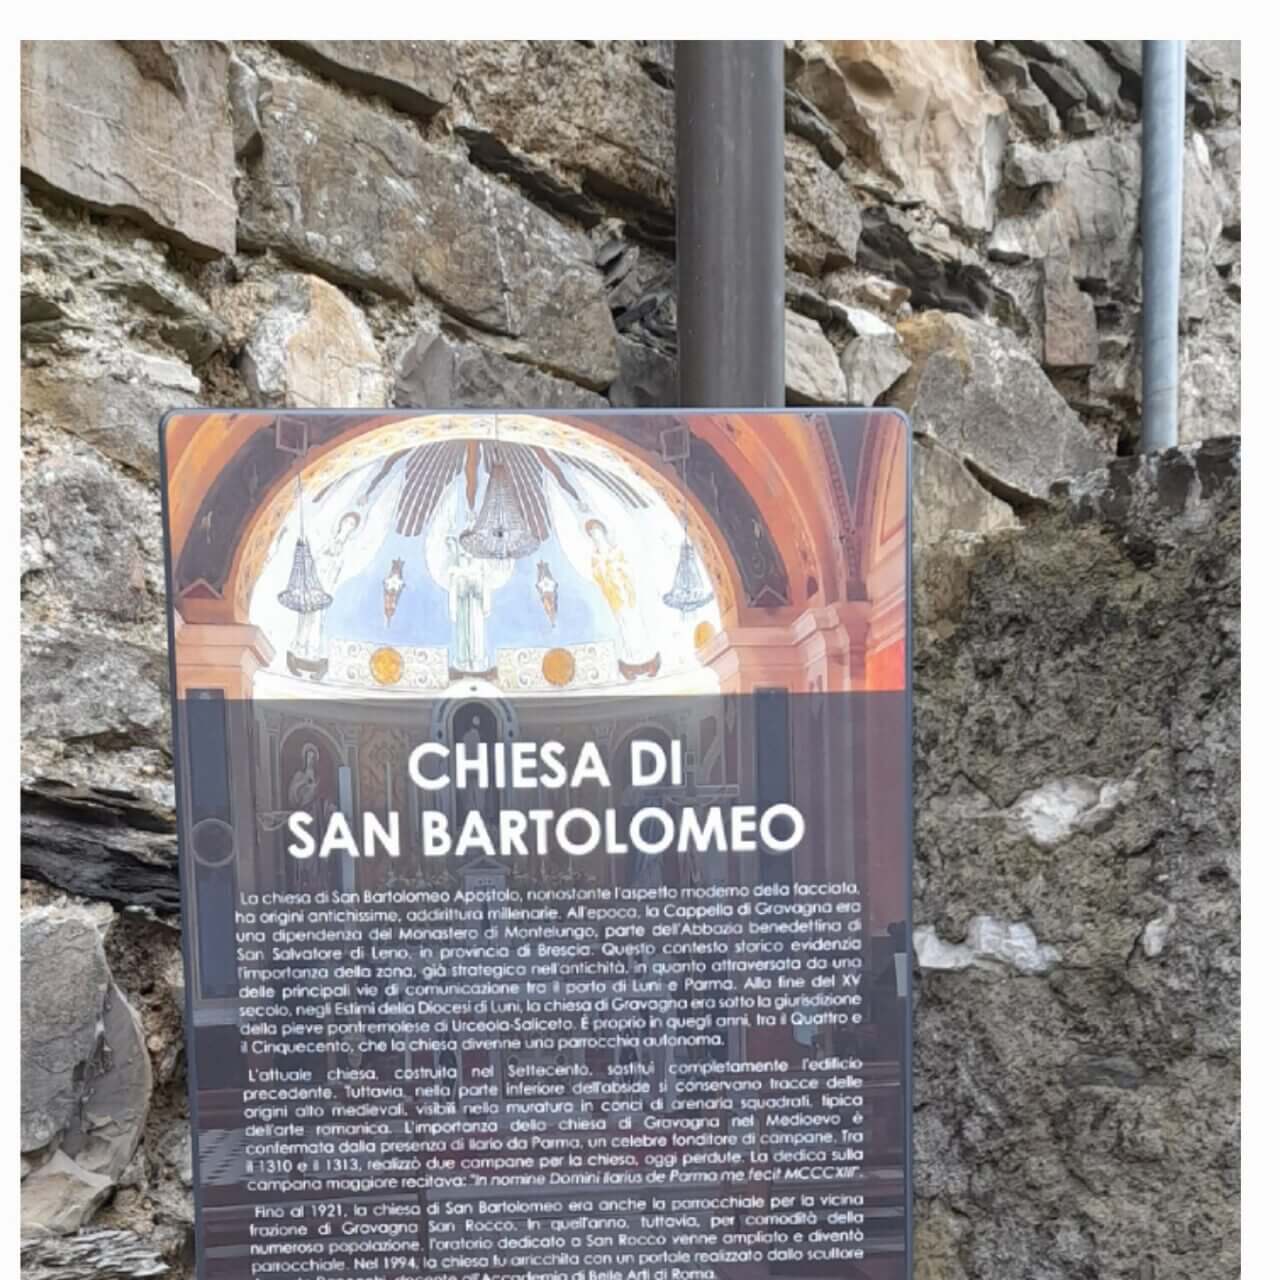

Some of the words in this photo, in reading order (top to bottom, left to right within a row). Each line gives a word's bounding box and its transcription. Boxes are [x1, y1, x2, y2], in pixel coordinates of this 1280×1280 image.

[408, 741, 610, 790] CHIESA
[631, 740, 681, 786] DI
[287, 810, 400, 859] SAN
[423, 803, 805, 857] BARTOLOMEO
[240, 892, 258, 905] La
[261, 891, 310, 904] chiesa
[314, 891, 329, 903] di
[331, 890, 359, 903] San
[363, 889, 449, 903] Bartolomeo
[453, 888, 522, 905] Apostolo,
[526, 886, 611, 900] nonostante
[680, 884, 749, 898] moderno
[753, 884, 789, 897] della
[235, 910, 255, 923] ha
[259, 910, 303, 926] origini
[406, 907, 483, 921] addirittura
[645, 904, 659, 917] la
[663, 903, 733, 920] Cappella
[737, 903, 751, 916] di
[754, 902, 832, 919] Gravagna
[836, 904, 861, 914] era
[235, 932, 265, 942] una
[272, 927, 361, 945] dipendenza
[368, 927, 391, 940] del
[398, 925, 478, 939] Monastero
[483, 925, 498, 938] di
[504, 923, 598, 941] Montelungo,
[605, 923, 644, 939] parte
[748, 919, 841, 933] benedettina
[847, 919, 861, 931] di
[236, 947, 264, 960] San
[272, 946, 341, 960] Salvatore
[350, 946, 364, 959] di
[419, 945, 432, 958] in
[439, 944, 509, 961] provincia
[517, 944, 530, 956] di
[601, 942, 655, 955] Questo
[662, 941, 728, 954] contesto
[734, 940, 783, 953] storico
[790, 939, 861, 952] evidenzia
[333, 964, 371, 977] della
[451, 962, 526, 979] strategica
[634, 960, 647, 973] in
[651, 959, 705, 976] quanto
[711, 958, 801, 972] attraversata
[806, 958, 827, 971] da
[831, 960, 861, 970] una
[251, 1039, 353, 1056] Cinquecento,
[357, 1038, 386, 1051] che
[391, 1038, 407, 1051] la
[407, 1037, 457, 1051] chiesa
[461, 1036, 520, 1050] divenne
[524, 1038, 554, 1049] una
[557, 1035, 639, 1052] parrocchia
[642, 1034, 724, 1047] autonoma.
[242, 1085, 336, 1102] precedente.
[415, 1083, 450, 1096] nella
[458, 1082, 497, 1099] parte
[506, 1081, 564, 1095] inferiore
[572, 1080, 649, 1094] dell'abside
[675, 1081, 762, 1092] conservano
[769, 1077, 818, 1090] tracce
[826, 1076, 862, 1090] delle
[245, 1140, 334, 1154] confermata
[338, 1139, 375, 1152] dalla
[380, 1140, 446, 1155] presenza
[450, 1137, 464, 1150] di
[506, 1136, 527, 1149] da
[531, 1135, 582, 1150] Parma,
[587, 1137, 606, 1148] un
[611, 1134, 666, 1147] celebre
[672, 1133, 737, 1146] fonditore
[741, 1132, 755, 1145] di
[760, 1133, 836, 1148] campane.
[842, 1130, 863, 1143] Tra
[249, 1221, 307, 1235] frazione
[317, 1221, 331, 1234] di
[341, 1219, 417, 1237] Gravagna
[428, 1219, 455, 1232] San
[526, 1217, 540, 1230] In
[710, 1216, 734, 1230] per
[827, 1211, 864, 1225] della
[250, 1242, 323, 1253] numerosa
[497, 1235, 565, 1248] dedicato
[586, 1234, 613, 1247] San
[618, 1233, 666, 1246] Rocco
[672, 1234, 717, 1245] venne
[722, 1230, 788, 1248] ampliato
[653, 1268, 667, 1280] di
